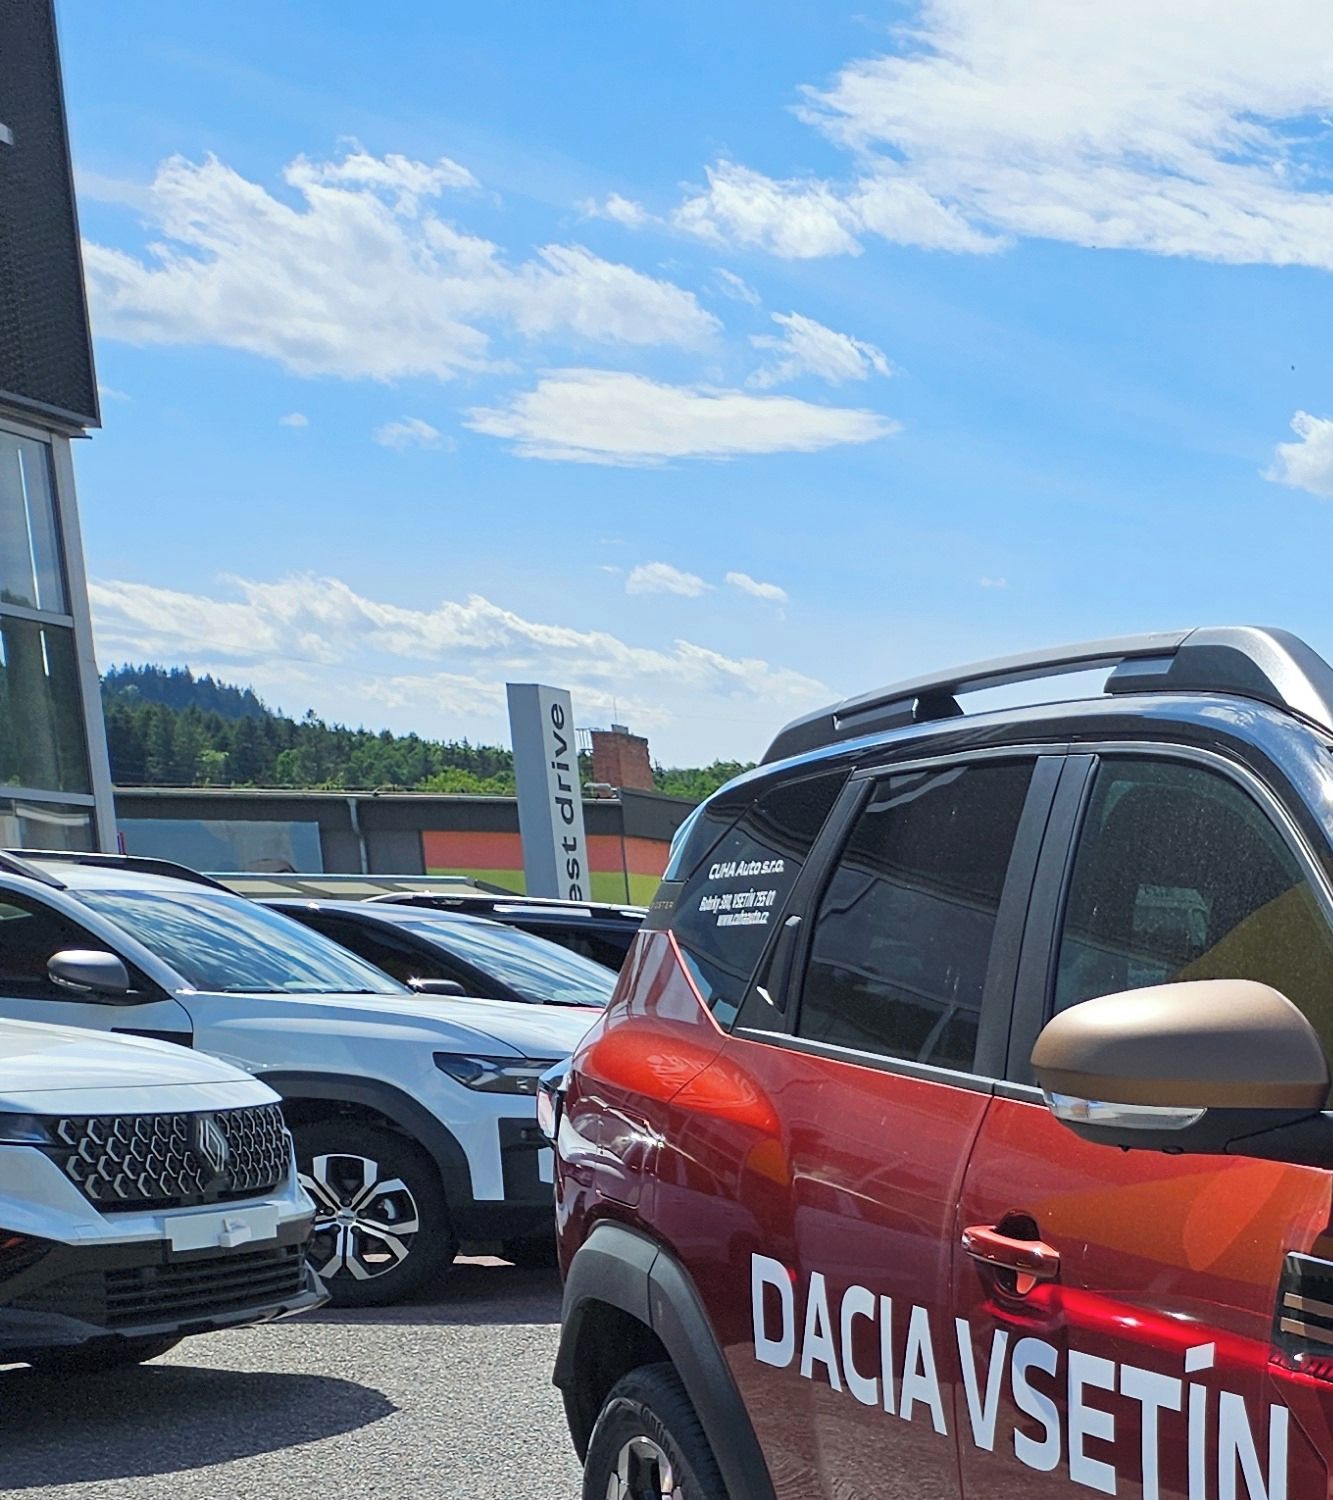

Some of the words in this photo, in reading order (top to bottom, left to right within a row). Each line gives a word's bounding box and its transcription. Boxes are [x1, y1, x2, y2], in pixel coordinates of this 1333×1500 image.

[551, 703, 575, 825] drive
[562, 836, 583, 901] est
[708, 861, 737, 880] CUHA
[734, 860, 762, 877] Auto
[751, 1252, 949, 1437] DACIA
